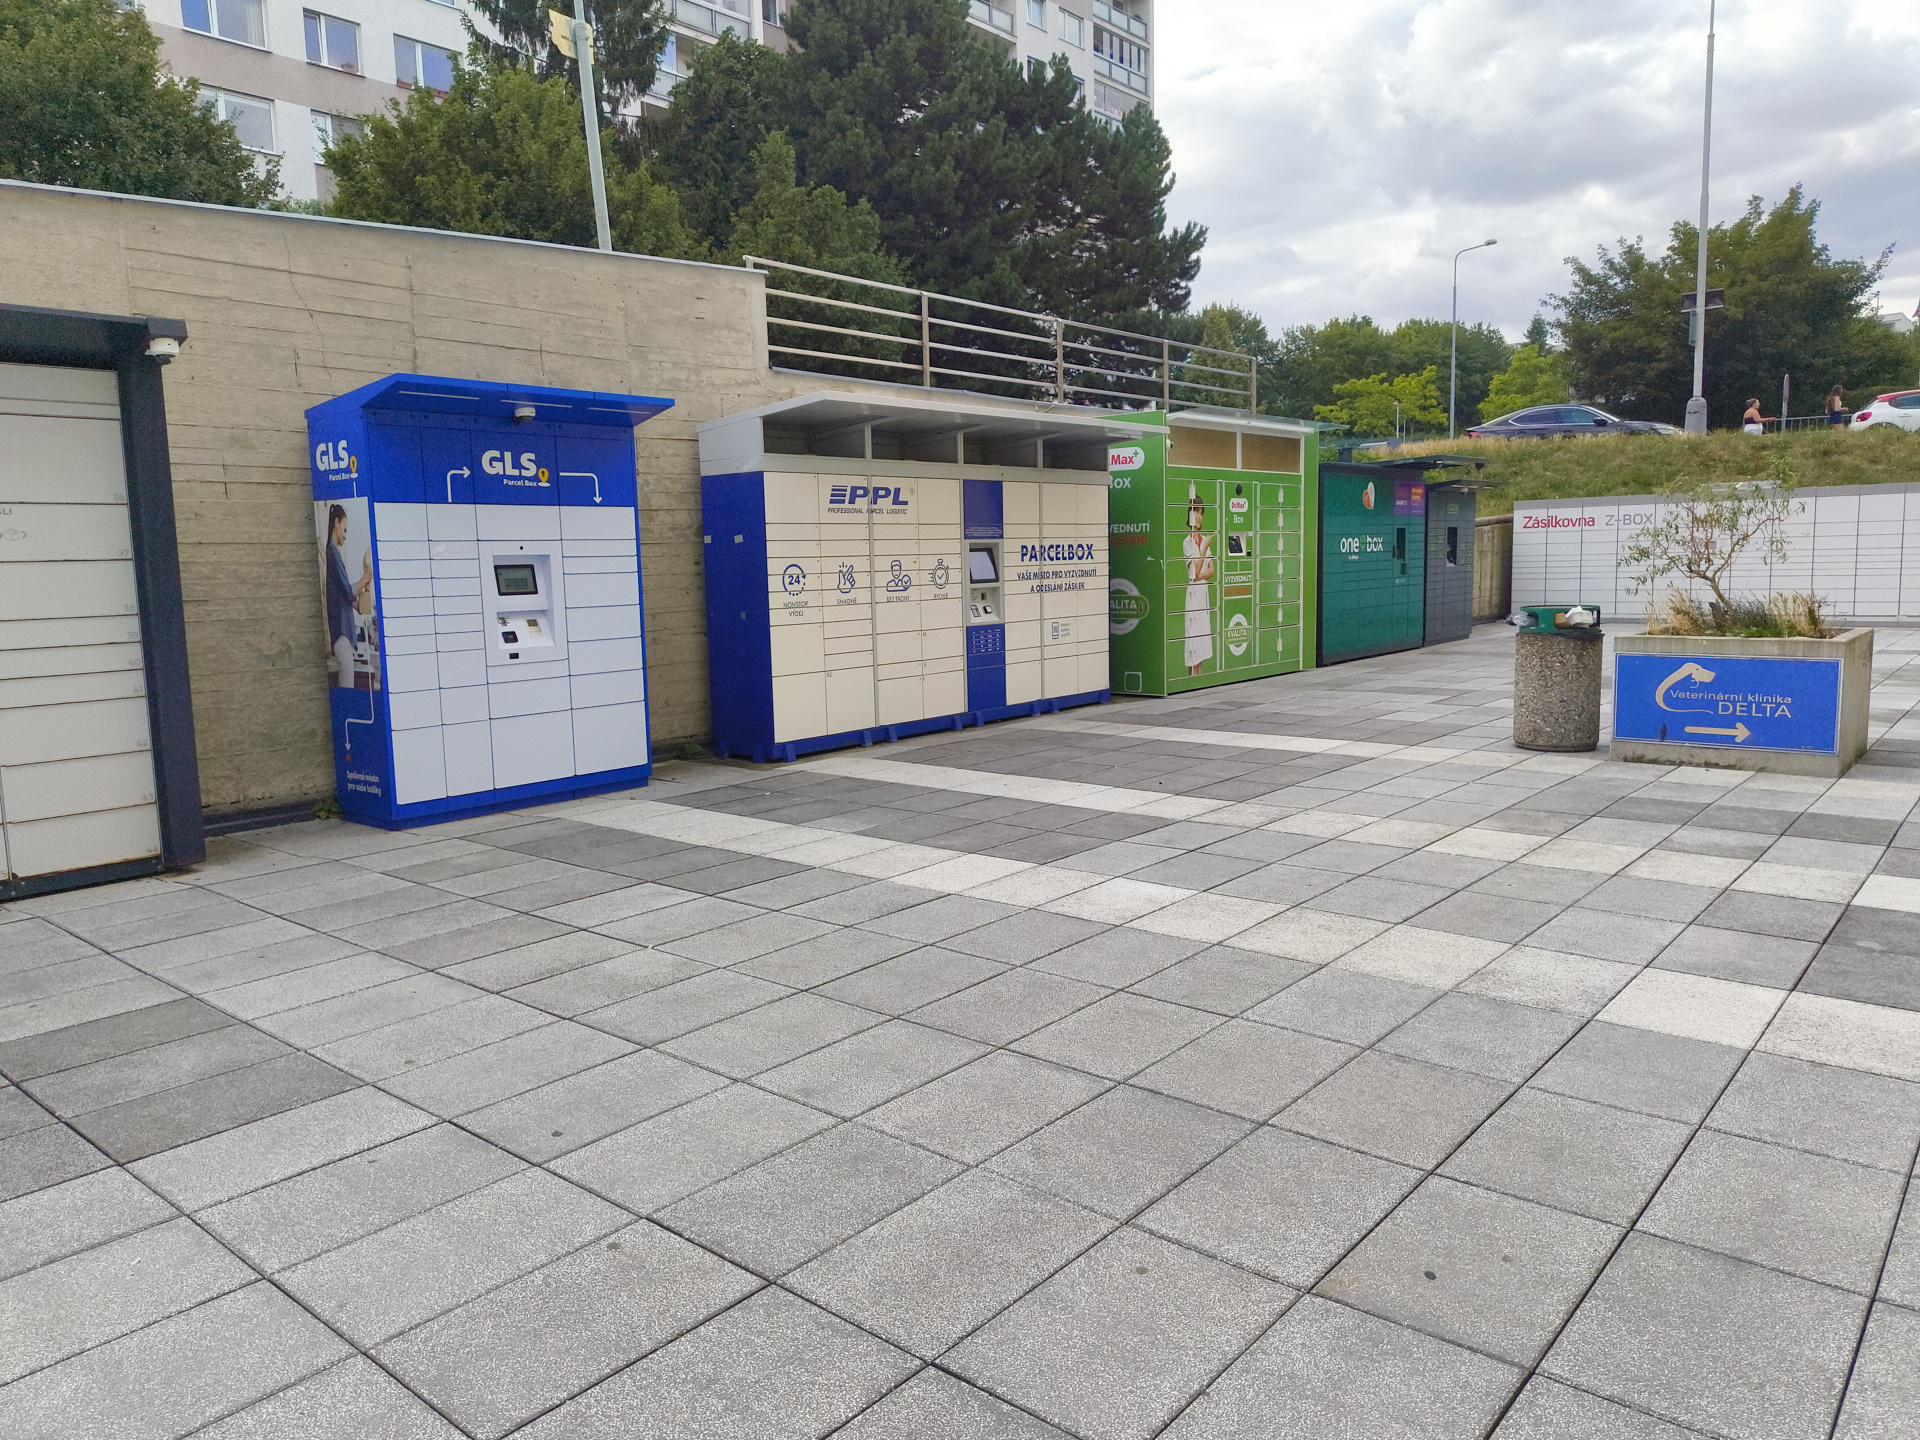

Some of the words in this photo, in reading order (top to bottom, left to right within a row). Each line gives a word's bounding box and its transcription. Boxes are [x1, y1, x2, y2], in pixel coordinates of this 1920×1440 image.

[316, 440, 349, 471] GLS
[481, 449, 537, 477] GLS
[848, 485, 909, 506] PPL
[1522, 515, 1596, 529] Zásilkovna
[1605, 513, 1654, 526] Z-BOX
[1340, 537, 1360, 552] one
[1366, 534, 1384, 552] box
[1020, 544, 1094, 562] PARCELBOX
[788, 575, 800, 586] 24
[1016, 570, 1032, 580] VAŠE
[1052, 570, 1062, 578] PRO
[1064, 580, 1084, 590] ZÁSIEK
[784, 601, 808, 609] NONSTOP
[1670, 690, 1742, 701] Veterinární
[1748, 693, 1792, 704] klinika
[1718, 702, 1792, 718] DELTA
